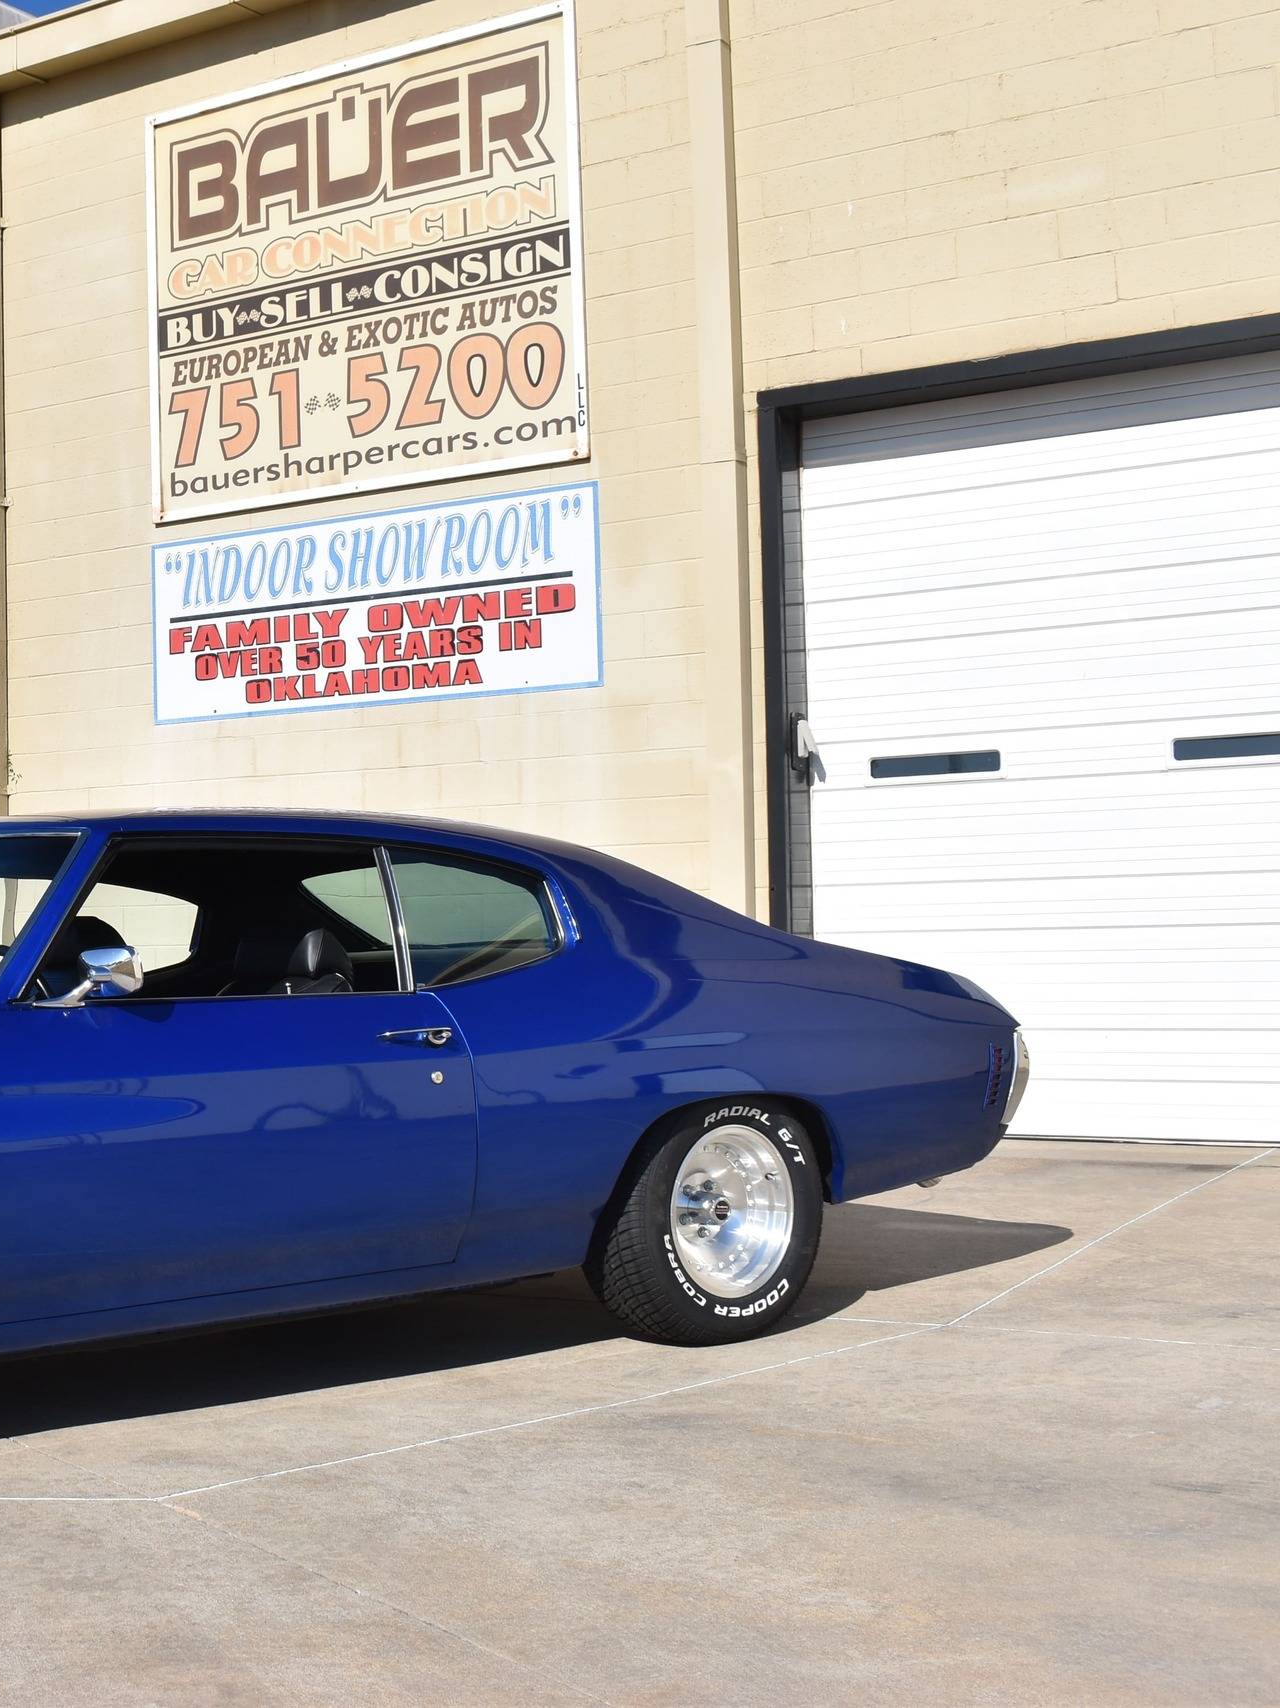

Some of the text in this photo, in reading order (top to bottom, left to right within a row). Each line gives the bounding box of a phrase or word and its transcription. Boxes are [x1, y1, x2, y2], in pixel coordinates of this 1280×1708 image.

[168, 175, 555, 299] CAR CONNECTION
[167, 235, 564, 349] BUY SELL CONSIGN
[172, 285, 558, 387] EUROPEAN & EXOTIC AUTOS
[168, 321, 566, 469] 751 5200
[577, 372, 586, 427] LLC
[170, 415, 578, 498] bauersharpercars.com
[169, 582, 577, 654] FAMILY OWNED
[195, 618, 542, 681] OVER 50 YEARS IN
[245, 659, 483, 704] OKLAHOMA
[703, 1105, 806, 1166] RADIAL G/T
[663, 1233, 790, 1318] COOPER COBRA
